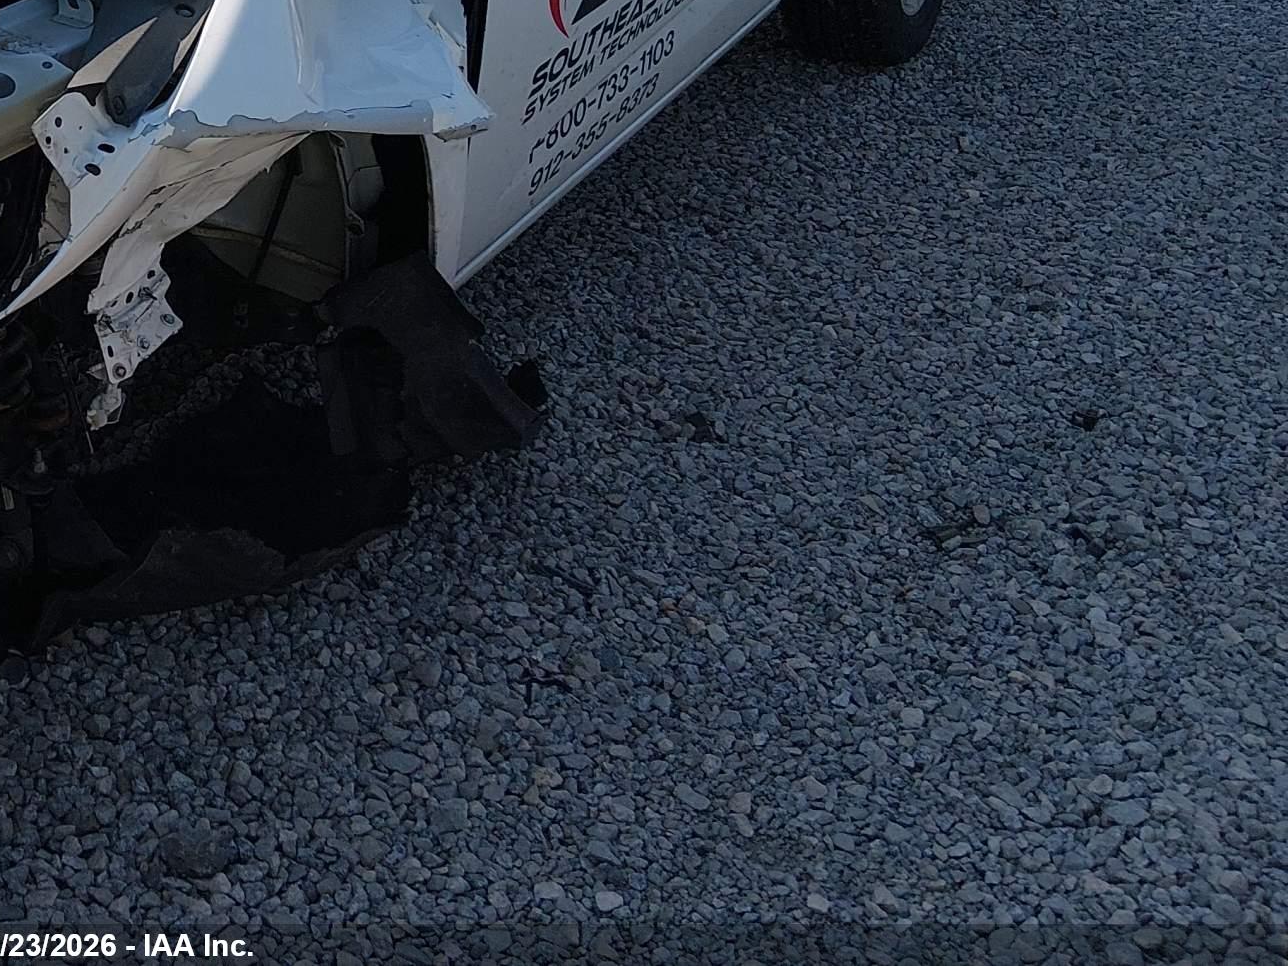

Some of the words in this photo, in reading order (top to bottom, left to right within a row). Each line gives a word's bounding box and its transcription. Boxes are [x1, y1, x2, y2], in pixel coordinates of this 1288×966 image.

[522, 55, 596, 125] SYSTEM
[528, 30, 675, 164] 1-800-733-1103
[528, 73, 660, 196] 912-355-8373
